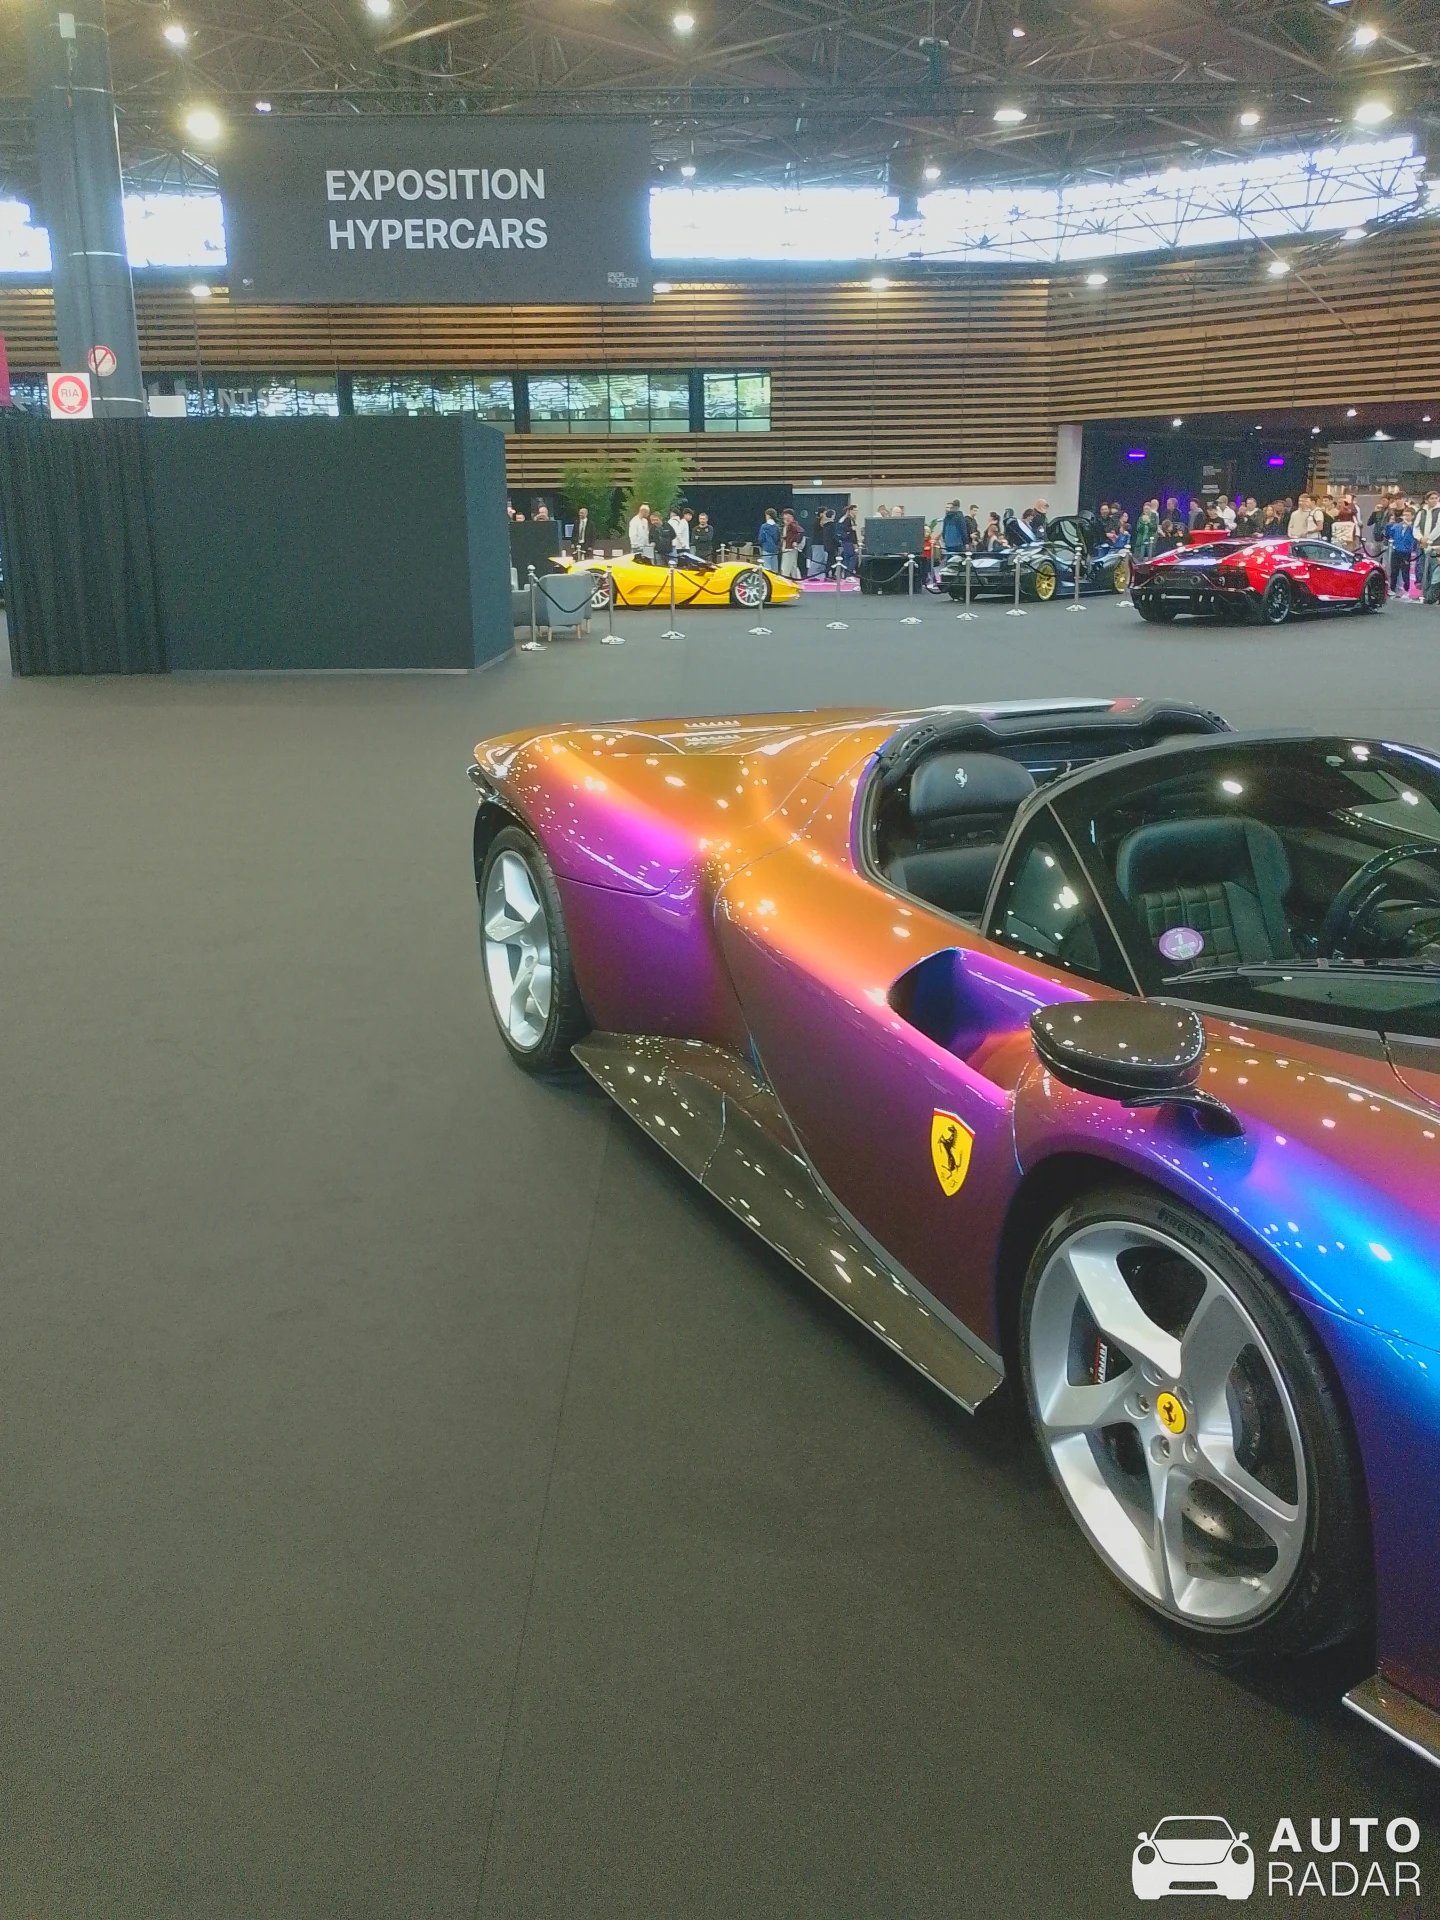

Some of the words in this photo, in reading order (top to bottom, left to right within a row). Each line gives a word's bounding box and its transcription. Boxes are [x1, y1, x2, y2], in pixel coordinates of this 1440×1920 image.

[326, 169, 545, 200] EXPOSITION
[329, 218, 548, 249] HYPERCARS
[60, 388, 80, 398] RIA
